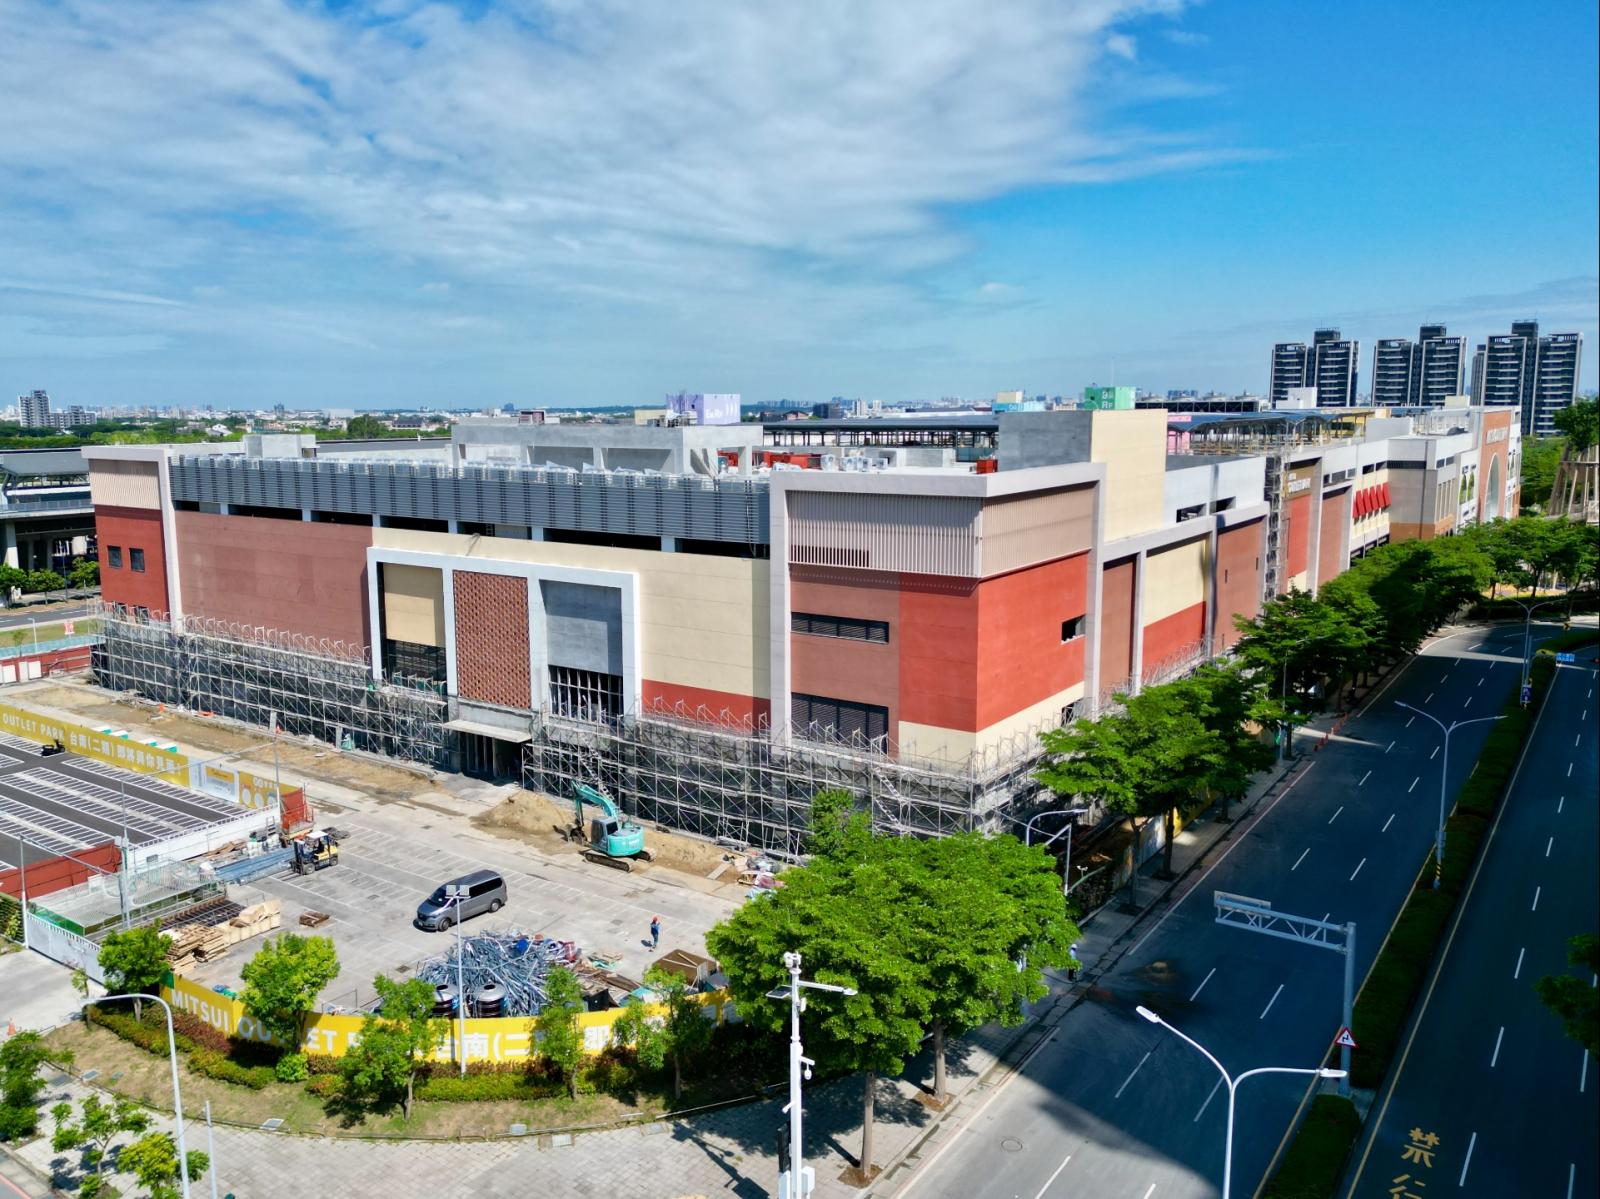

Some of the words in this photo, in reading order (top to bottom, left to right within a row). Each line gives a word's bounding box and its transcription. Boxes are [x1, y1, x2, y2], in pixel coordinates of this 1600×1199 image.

[3, 712, 37, 732] OUTLET
[40, 722, 65, 742] PARK
[172, 989, 229, 1033] MITSUI
[238, 1015, 337, 1053] OUET
